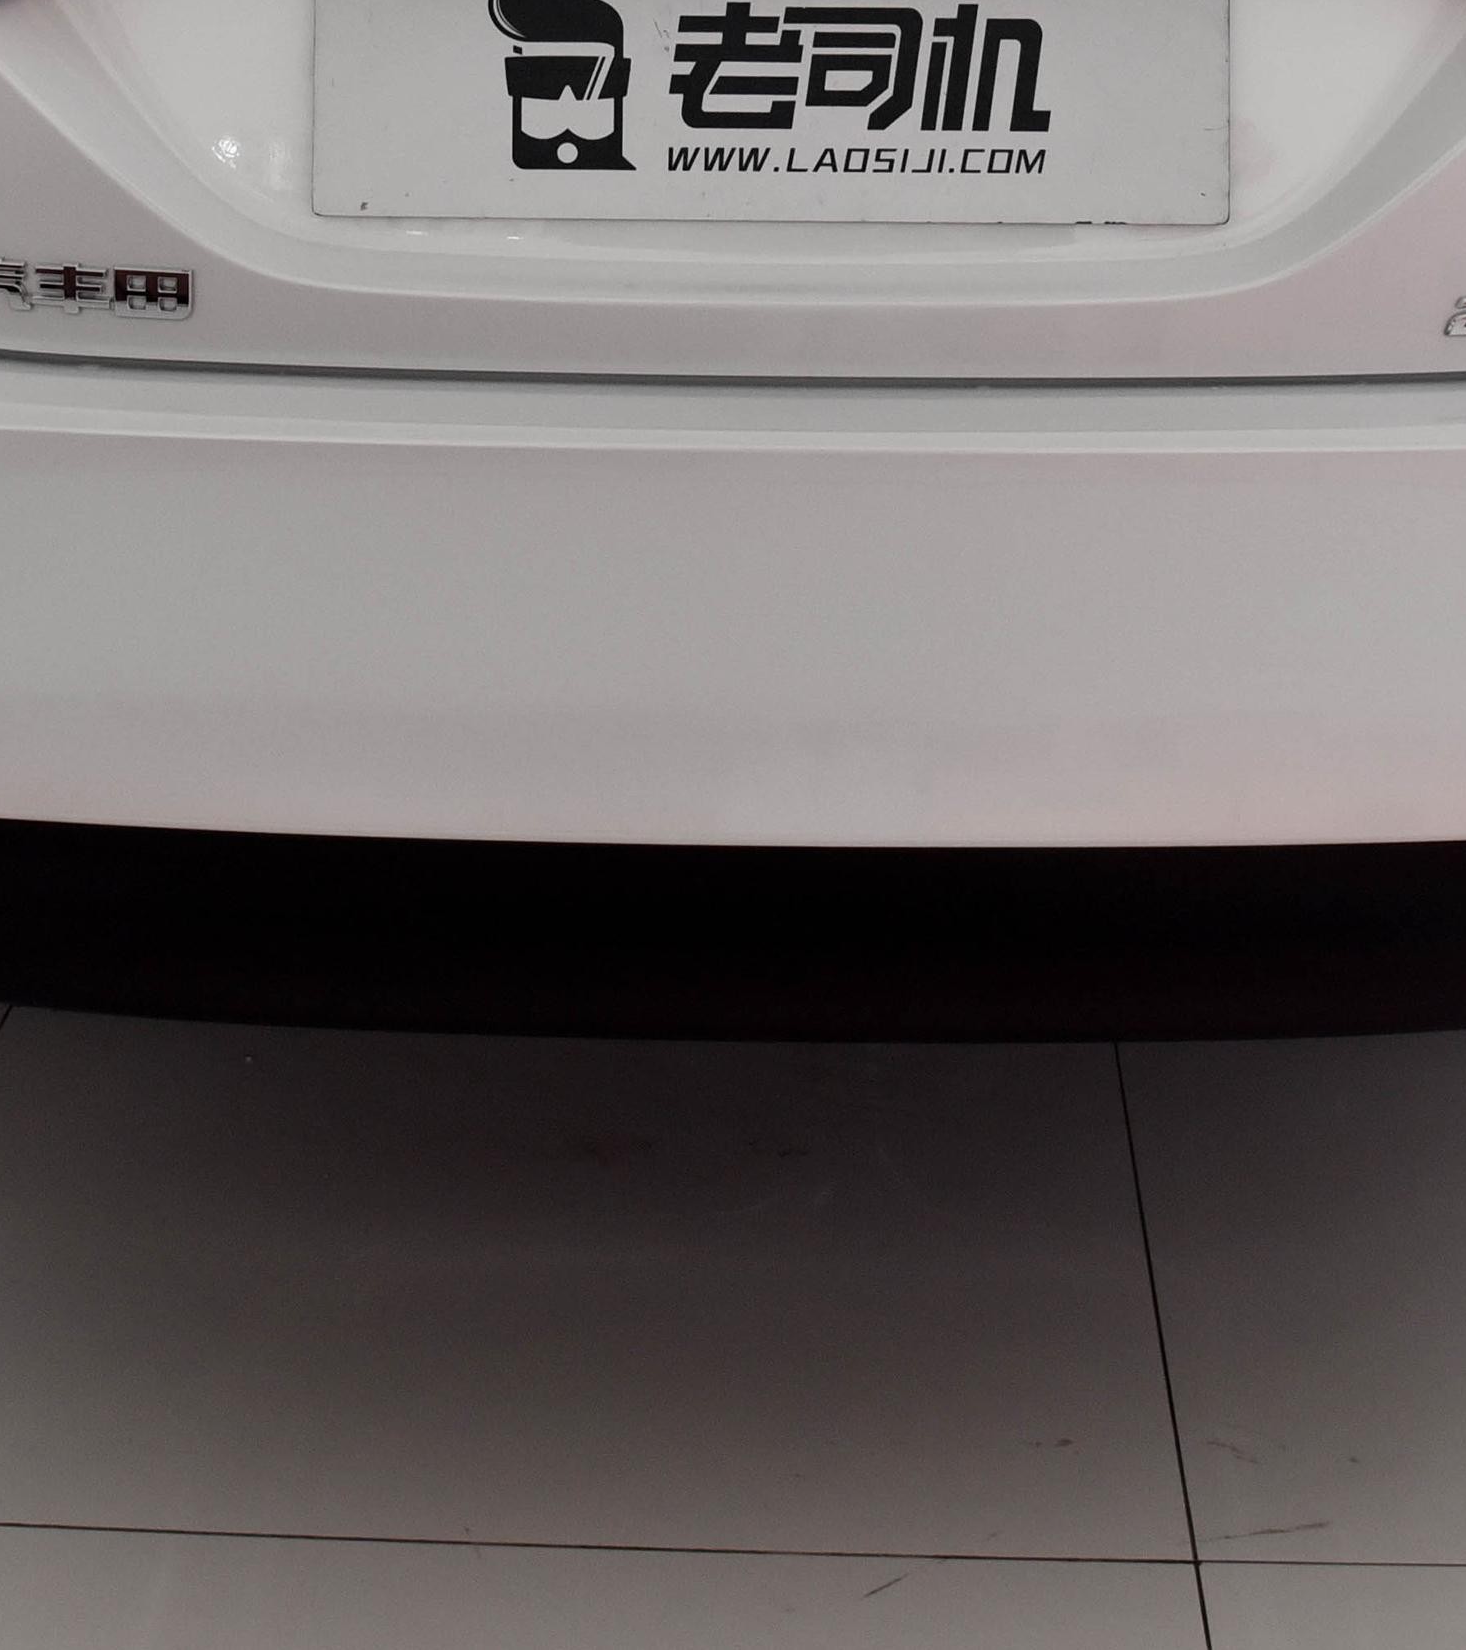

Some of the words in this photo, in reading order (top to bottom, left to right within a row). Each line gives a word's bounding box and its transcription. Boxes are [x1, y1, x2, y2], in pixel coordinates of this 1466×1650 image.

[668, 1, 1052, 132] 老司机
[666, 146, 1047, 175] WWW.LAOSIJI.COM
